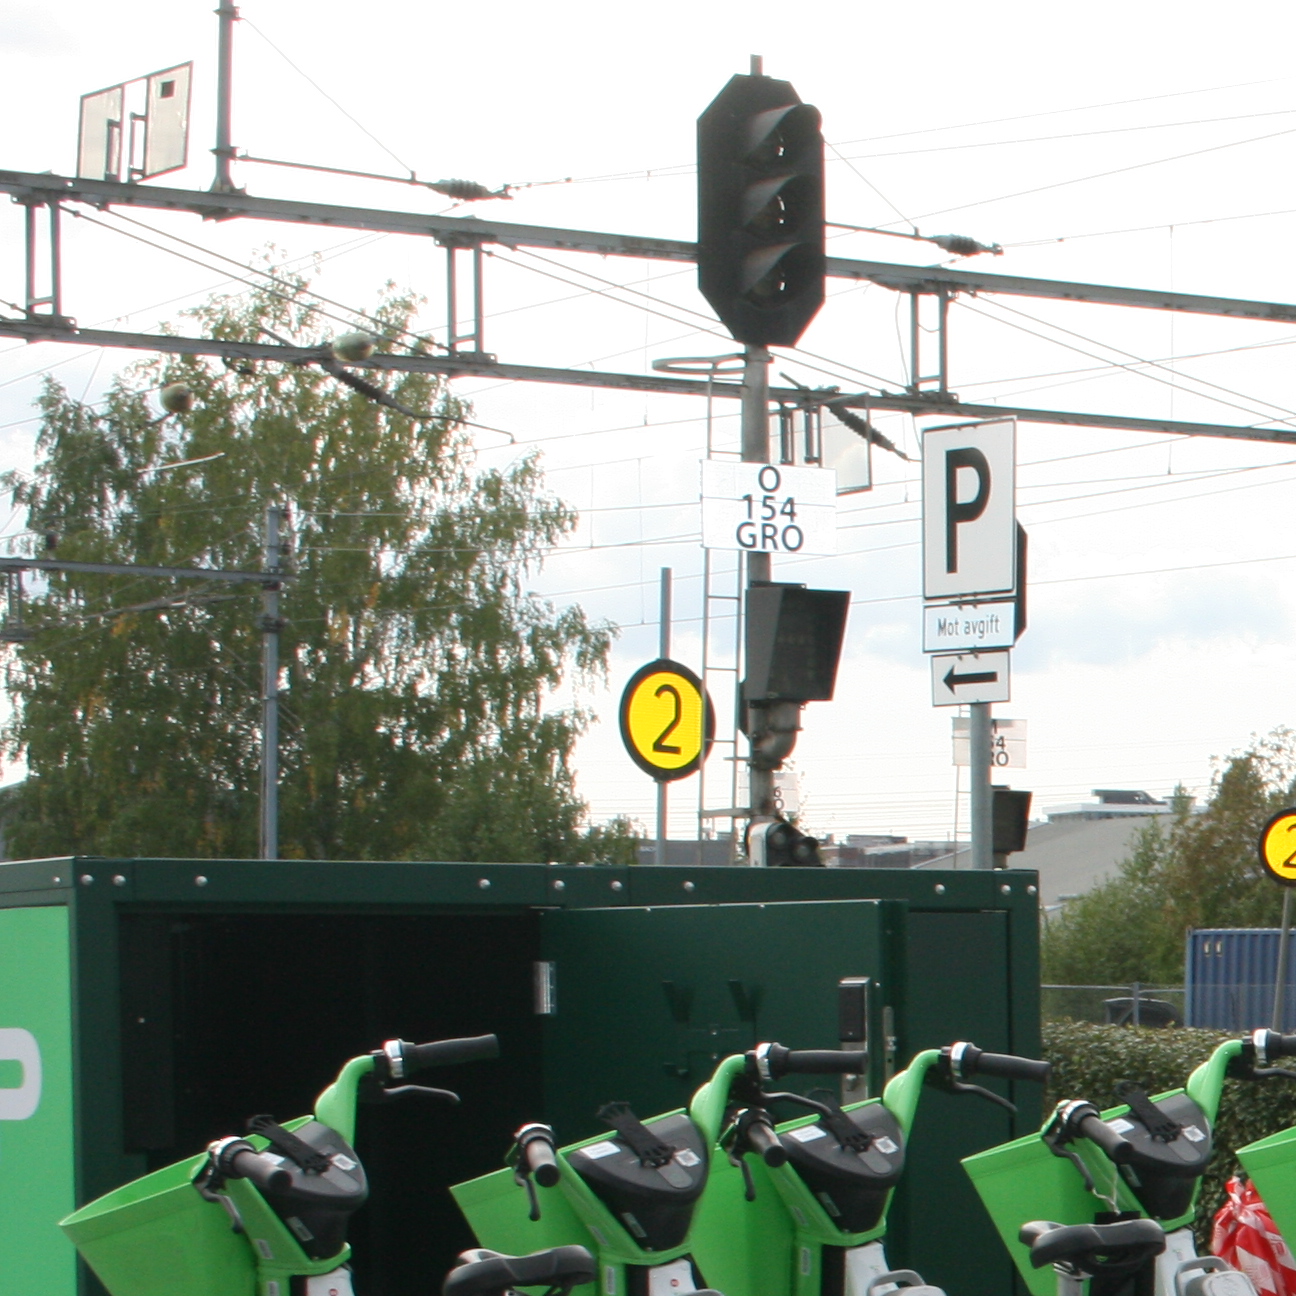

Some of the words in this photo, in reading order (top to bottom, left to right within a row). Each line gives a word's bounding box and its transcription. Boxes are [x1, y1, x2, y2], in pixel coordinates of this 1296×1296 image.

[741, 494, 798, 523] 154
[945, 446, 992, 574] P
[735, 522, 804, 552] GRO
[936, 617, 961, 638] Mot
[963, 614, 1001, 637] avgift
[651, 683, 682, 755] 2
